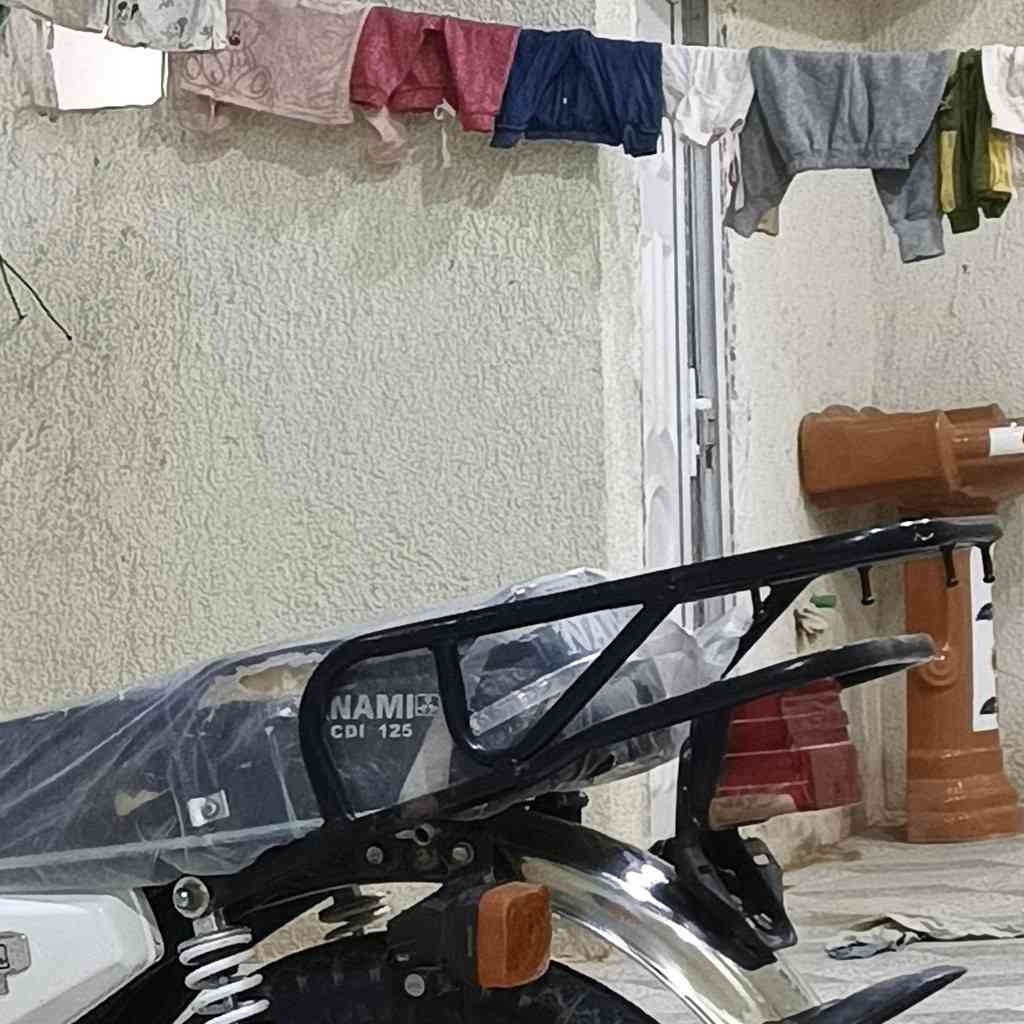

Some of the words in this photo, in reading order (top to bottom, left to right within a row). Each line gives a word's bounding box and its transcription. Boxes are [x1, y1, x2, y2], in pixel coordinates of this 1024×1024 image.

[330, 694, 414, 720] NAMI
[330, 723, 365, 739] CDI
[379, 723, 414, 739] 125
